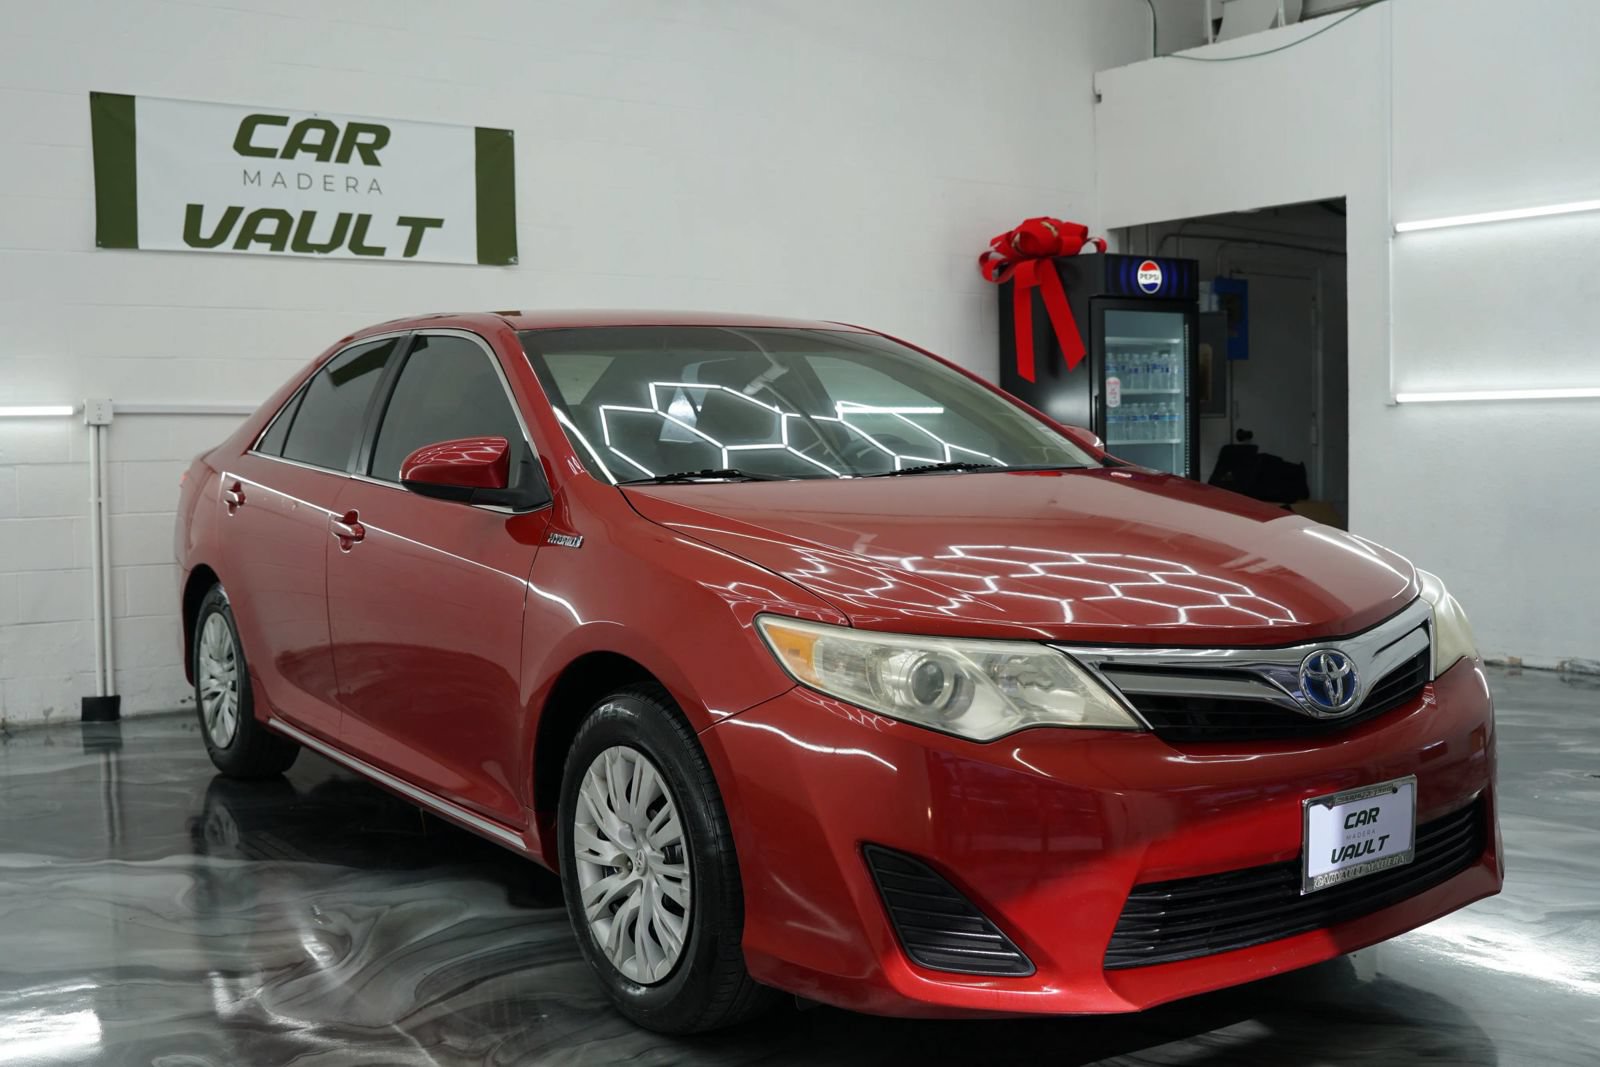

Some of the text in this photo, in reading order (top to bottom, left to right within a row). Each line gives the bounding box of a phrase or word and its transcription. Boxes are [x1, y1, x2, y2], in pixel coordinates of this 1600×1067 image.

[232, 113, 391, 167] CAR
[242, 169, 384, 195] MADERA
[182, 203, 445, 258] VAULT
[1140, 273, 1159, 281] PEPSI
[1344, 807, 1380, 830] CAR
[1346, 829, 1376, 840] MADERA
[1331, 834, 1390, 864] VAULT
